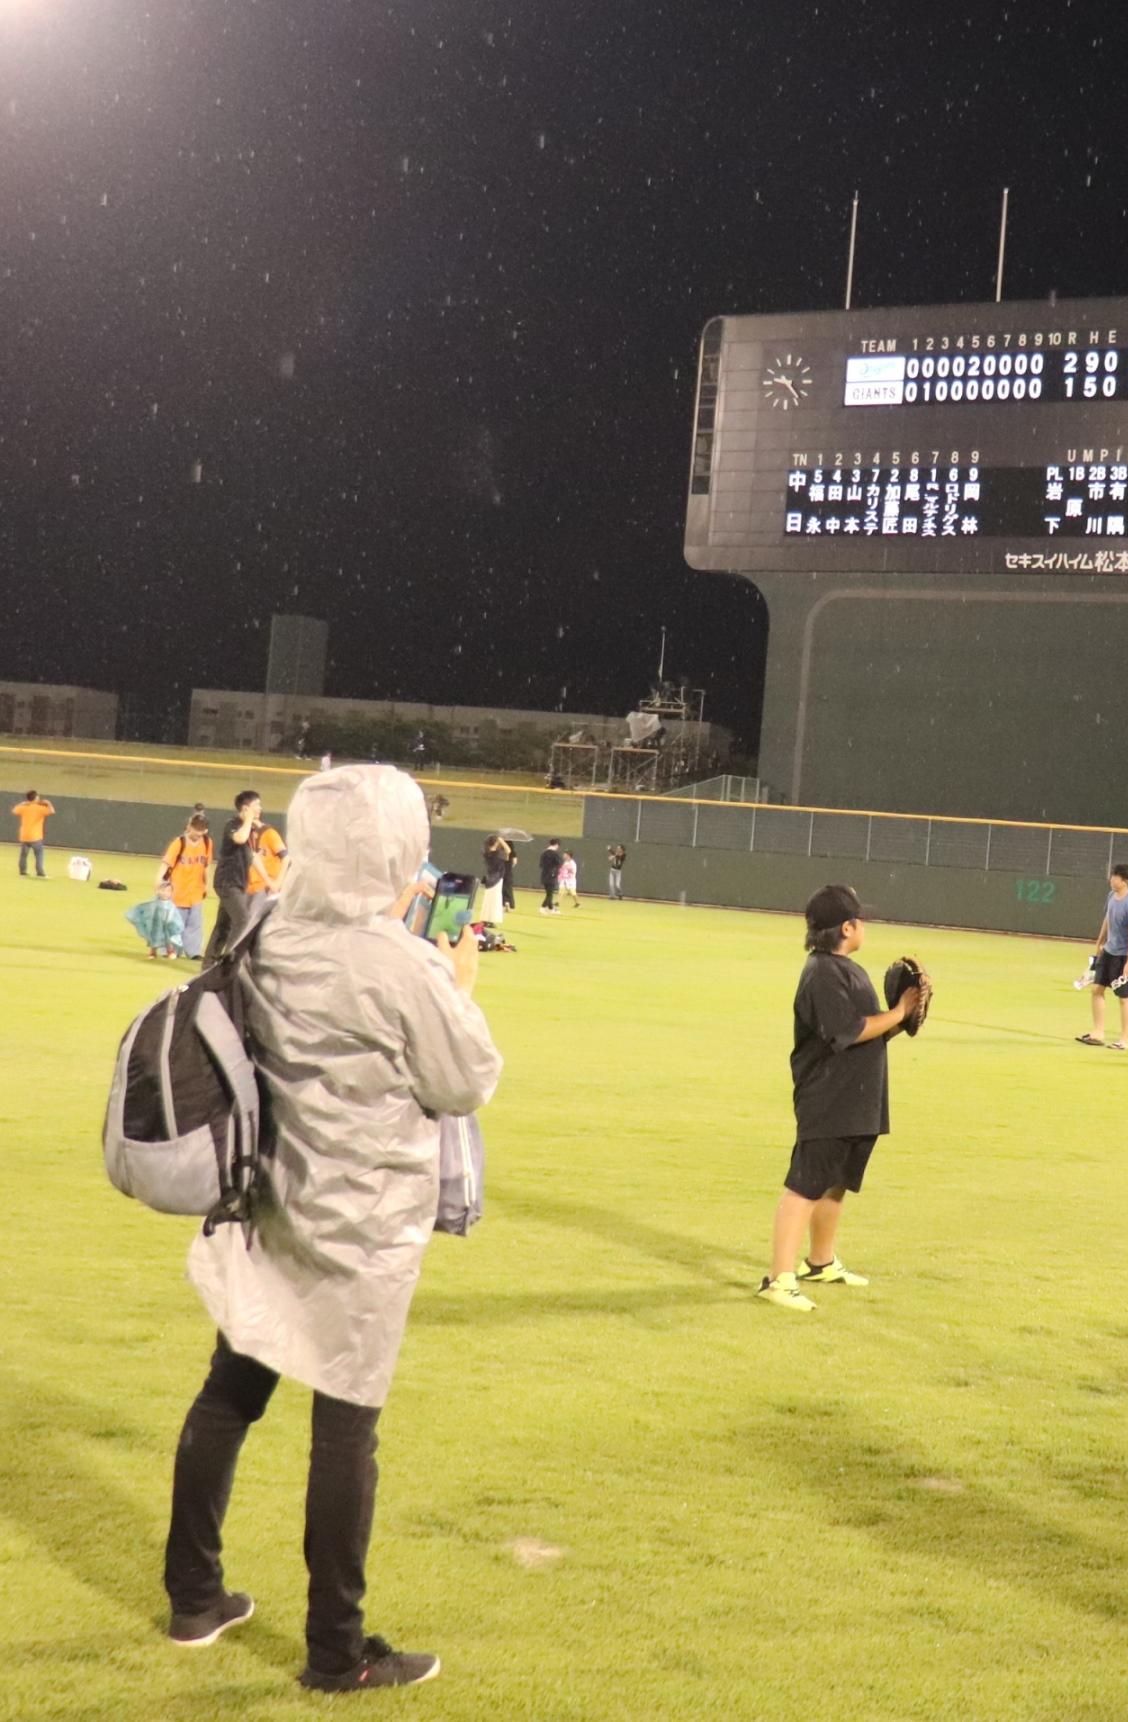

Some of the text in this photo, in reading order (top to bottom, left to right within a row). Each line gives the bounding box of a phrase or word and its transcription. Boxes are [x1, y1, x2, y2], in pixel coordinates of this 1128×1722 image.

[861, 330, 1116, 353] TEAM 1 2 3 4 5 6 7 8 9 10 R H E
[853, 388, 896, 399] GIANTS
[793, 451, 979, 466] TN 1 2 3 4 5 6 7 8 9
[814, 468, 978, 483] 5 4 3 7 2 8 1 6 9
[1047, 467, 1127, 481] PL 1B 2B 3B
[826, 485, 842, 534] 田中
[844, 485, 861, 534] 山本
[1066, 499, 1082, 517] 原
[1015, 879, 1056, 905] 122
